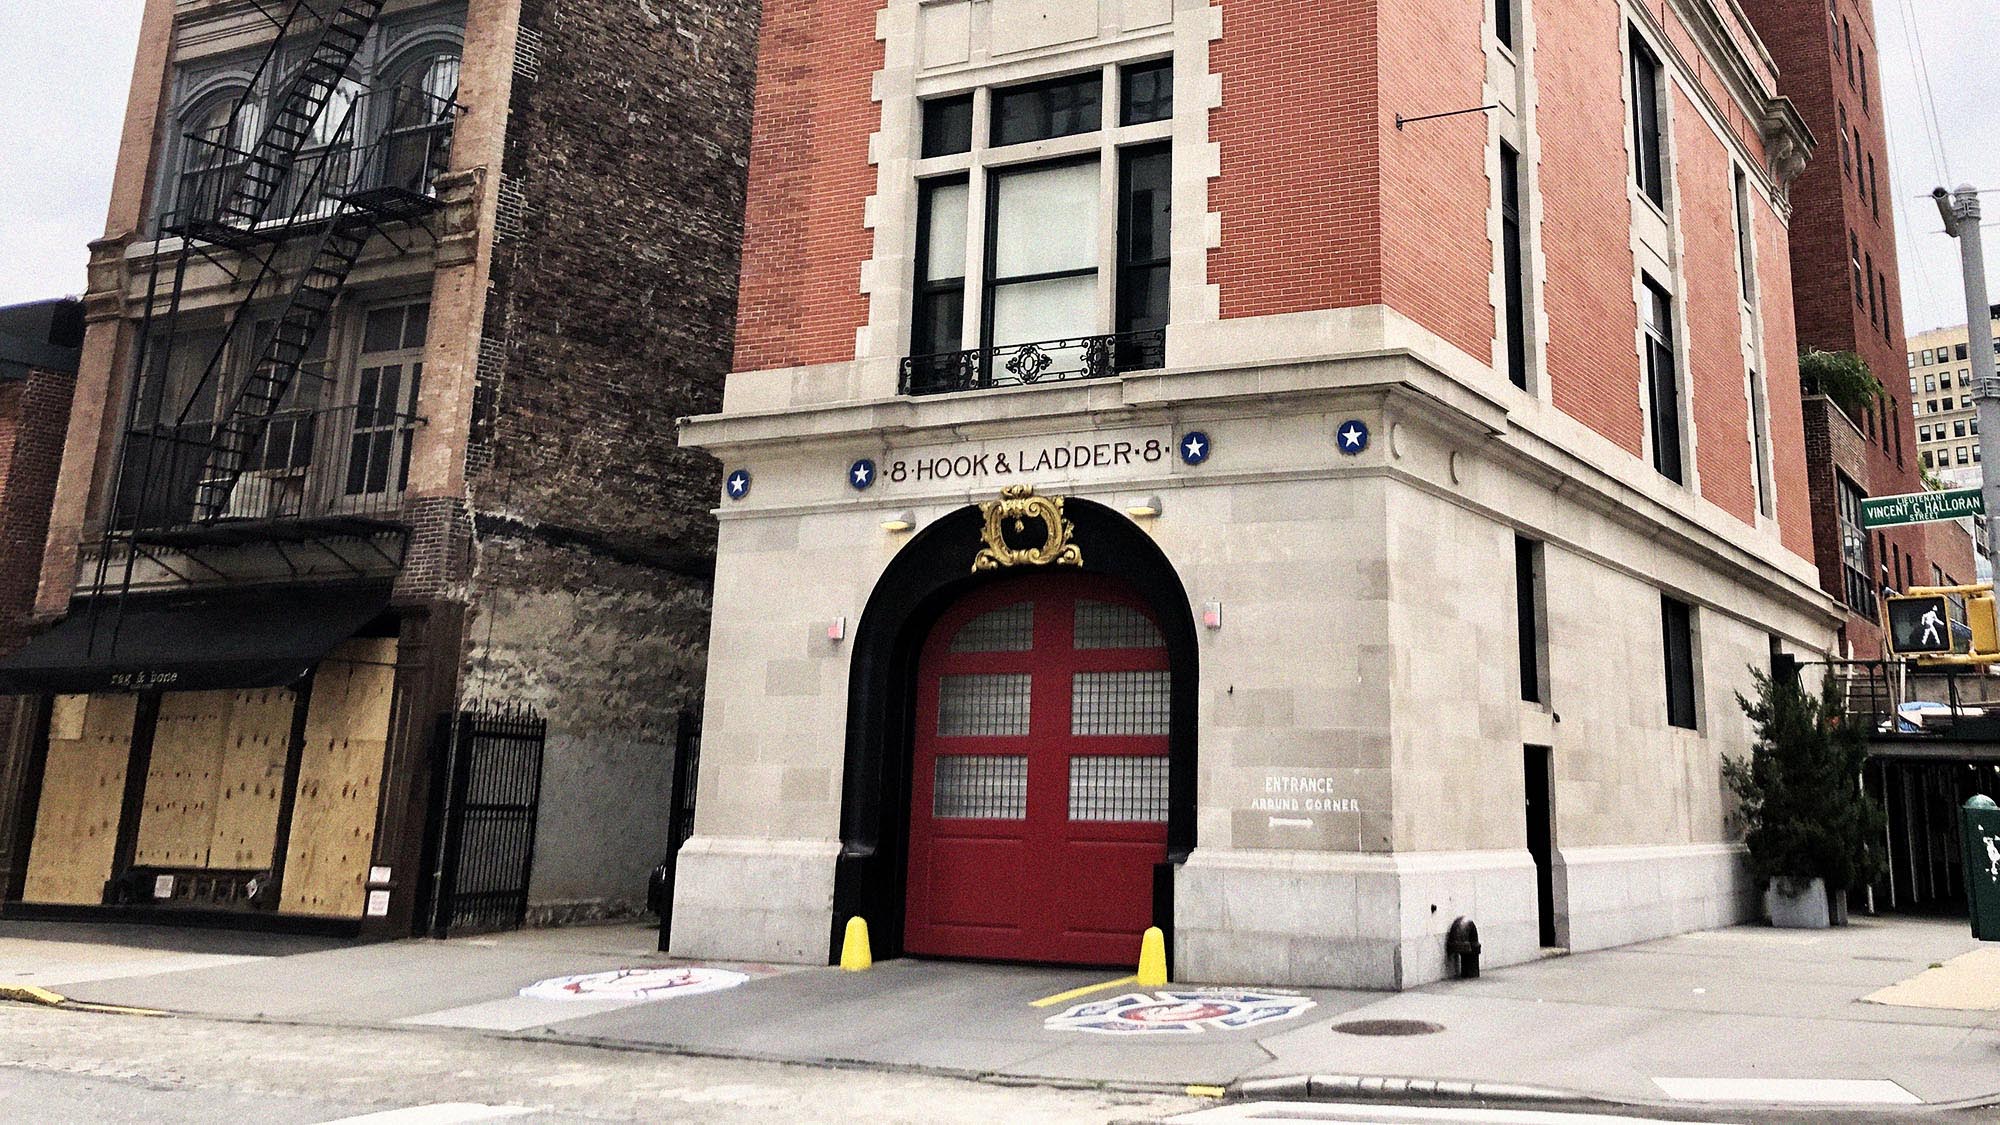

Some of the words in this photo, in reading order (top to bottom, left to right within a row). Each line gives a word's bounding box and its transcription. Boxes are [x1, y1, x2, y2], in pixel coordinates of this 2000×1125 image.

[917, 453, 990, 481] HOOK
[994, 452, 1012, 474] &
[1018, 441, 1132, 472] LADDER
[1896, 494, 1946, 505] LIEUTENANT
[1866, 504, 1909, 519] VINCENT
[1913, 502, 1920, 514] G
[1924, 496, 1981, 514] HALLORAN
[1909, 512, 1940, 522] STREET
[111, 673, 132, 686] rag
[136, 671, 145, 683] &
[1265, 776, 1334, 793] ENTRANCE
[1250, 798, 1299, 811] AROUND
[1305, 798, 1360, 812] CORNER
